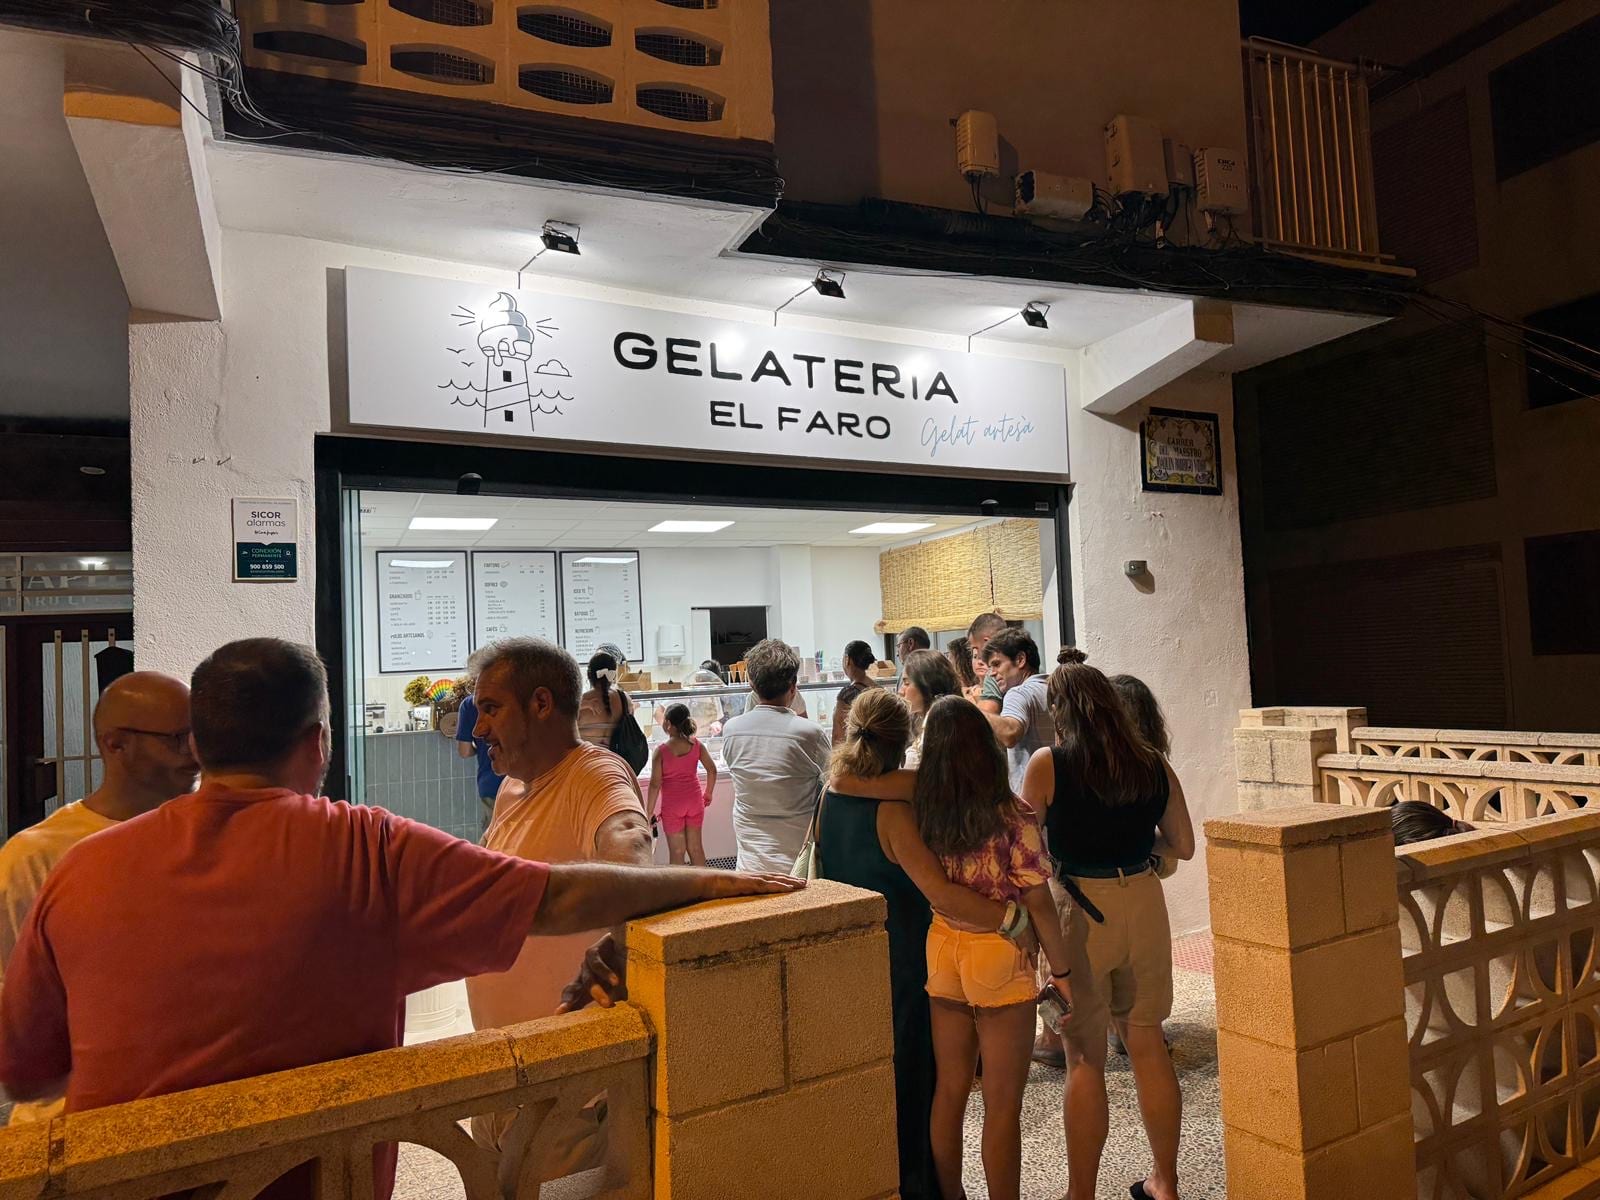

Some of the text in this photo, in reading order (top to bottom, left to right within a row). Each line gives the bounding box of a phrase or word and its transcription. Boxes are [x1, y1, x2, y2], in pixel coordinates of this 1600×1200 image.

[613, 331, 959, 404] GELATERIA
[710, 400, 891, 439] EL FARO
[920, 415, 979, 457] Gelat
[246, 519, 286, 527] alarmas
[251, 511, 281, 519] SICOR
